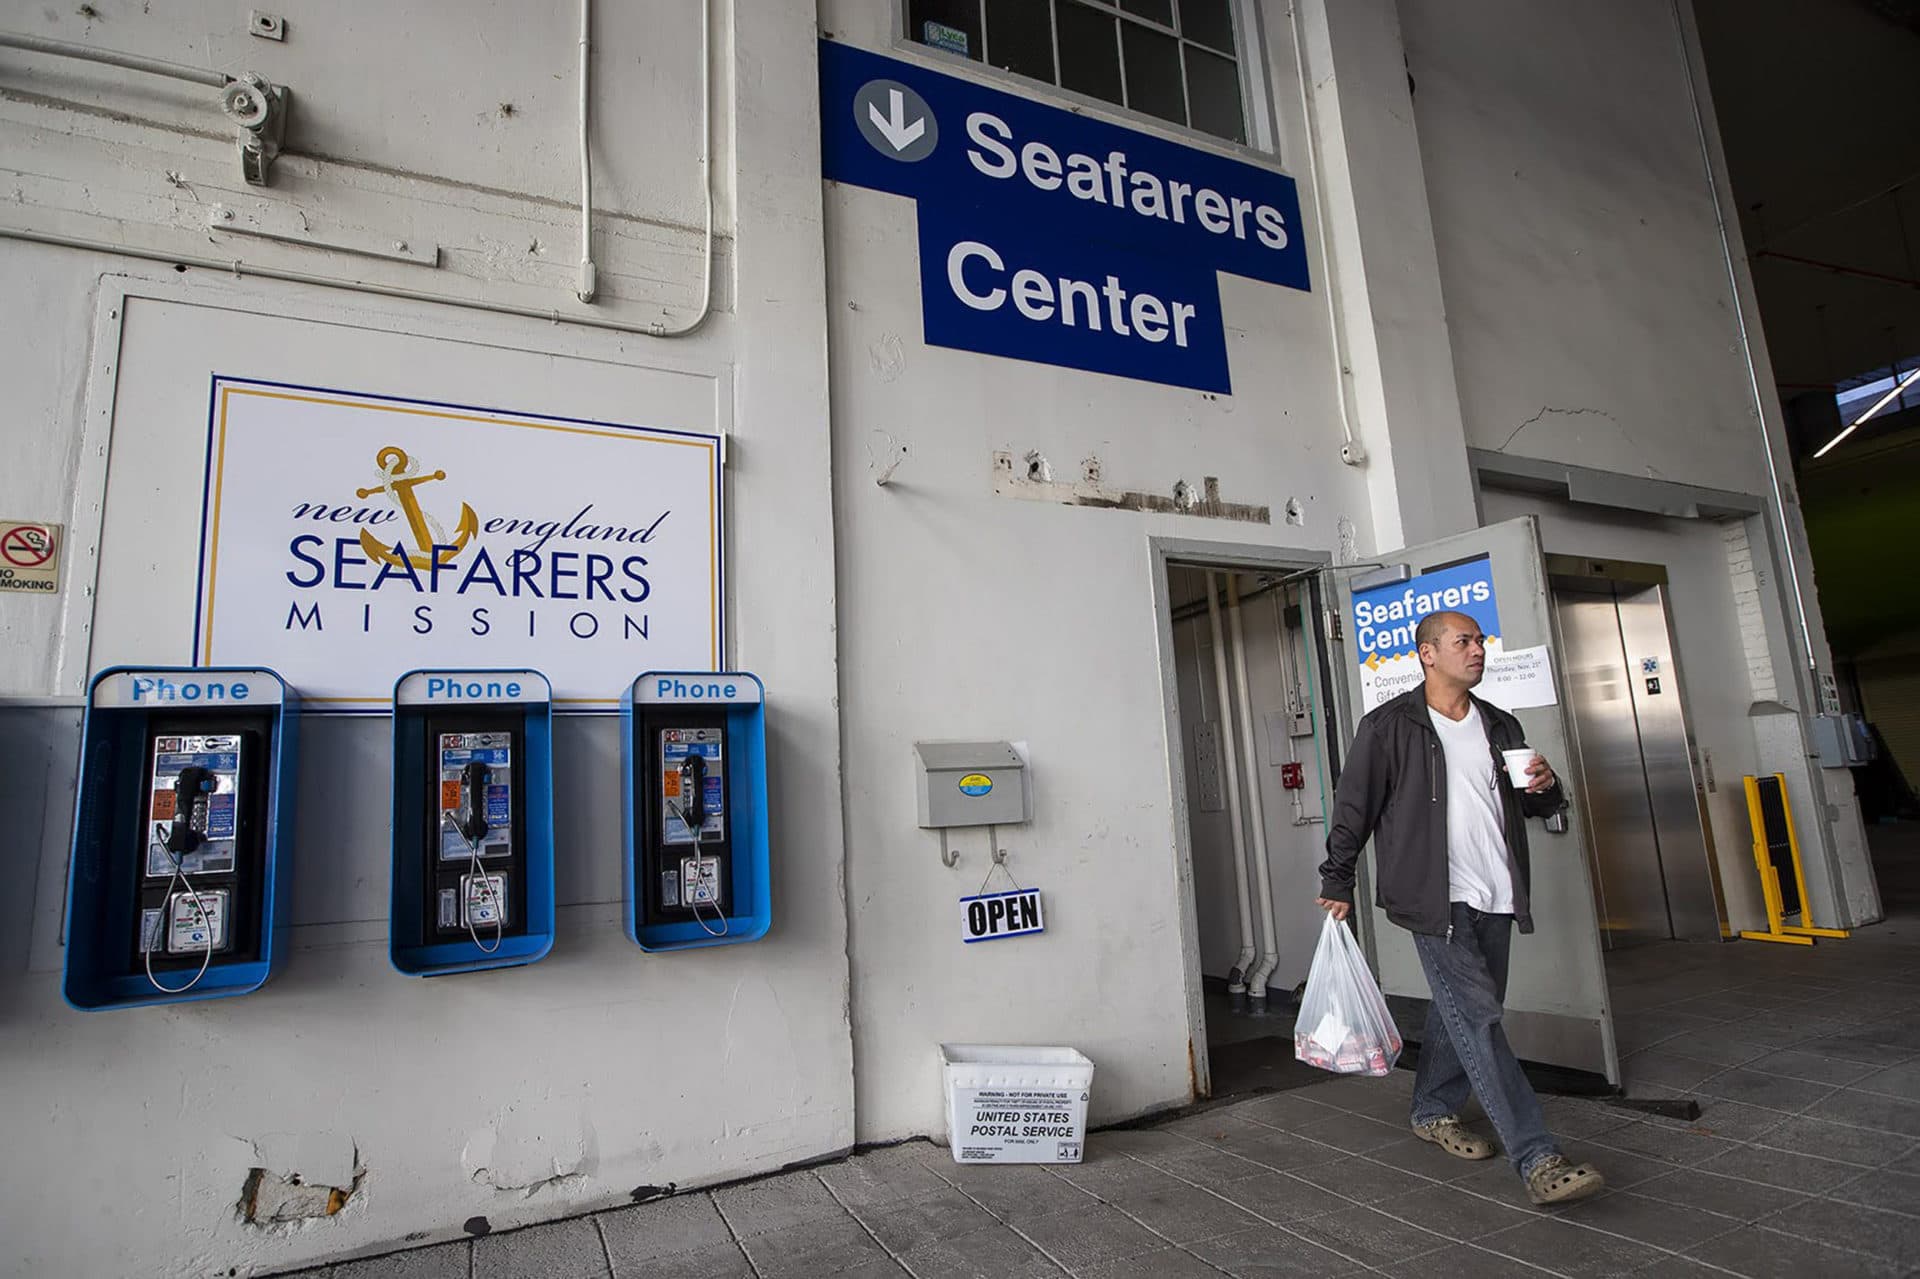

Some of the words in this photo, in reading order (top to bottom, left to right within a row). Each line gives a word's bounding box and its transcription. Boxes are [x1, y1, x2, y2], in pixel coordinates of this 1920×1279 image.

[966, 111, 1288, 250] Seafarers
[947, 240, 1196, 347] Center
[293, 499, 398, 525] new
[483, 504, 672, 566] england
[0, 579, 54, 590] MOKING
[286, 534, 651, 602] SEAFARERS
[1354, 580, 1490, 627] Seafarers
[285, 601, 650, 641] MISSION
[1358, 619, 1418, 653] Cent
[133, 678, 248, 700] Phone
[427, 677, 522, 699] Phone
[657, 679, 737, 698] Phone
[1375, 671, 1423, 688] Convenie
[967, 894, 1039, 937] OPEN
[970, 1125, 1019, 1137] POSTAL
[1021, 1126, 1075, 1138] SERVICE
[976, 1112, 1021, 1123] UNITED
[1023, 1112, 1070, 1124] STATES
